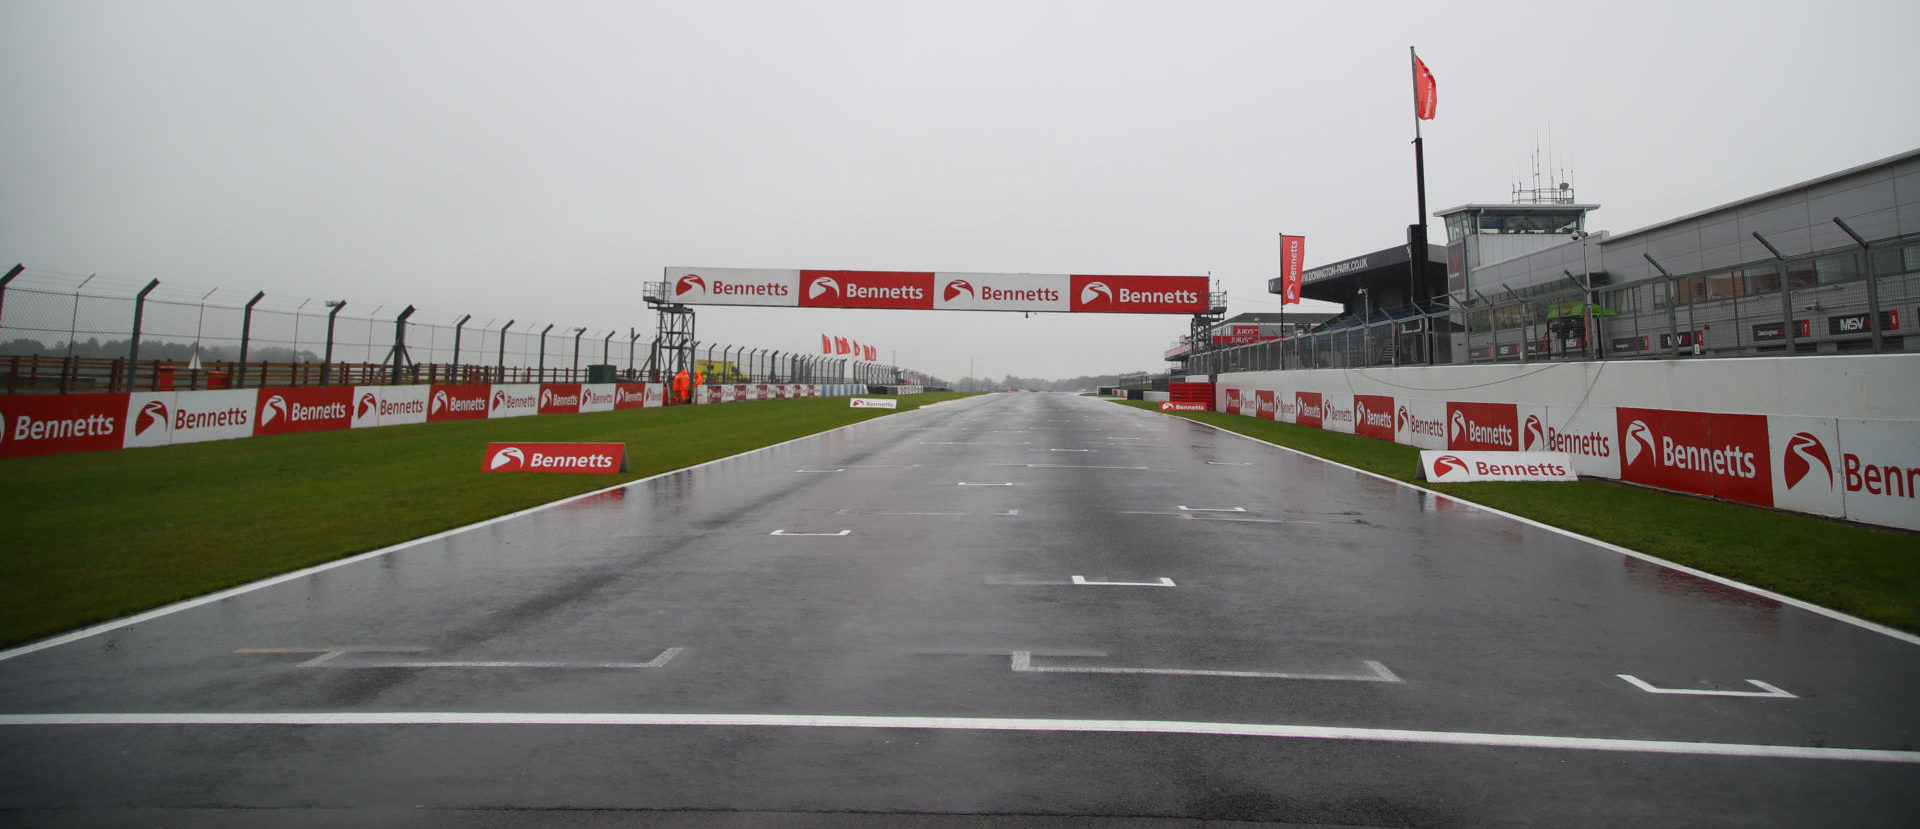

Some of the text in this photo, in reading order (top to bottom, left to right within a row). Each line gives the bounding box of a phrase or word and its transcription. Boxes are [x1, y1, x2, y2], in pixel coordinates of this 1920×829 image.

[1288, 240, 1298, 281] Bennetts
[712, 279, 789, 298] Bennetts
[847, 281, 924, 300] Bennetts
[982, 283, 1059, 302] Bennetts
[1119, 286, 1198, 305] Bennetts
[1839, 316, 1865, 331] MSV
[380, 397, 424, 416] Bennetts
[451, 396, 486, 412] Bennetts
[507, 395, 536, 408] Bennetts
[552, 393, 578, 407] Bennetts
[175, 407, 248, 430] Bennetts
[291, 402, 347, 421] Bennetts
[1332, 407, 1353, 423] Bennetts
[1367, 409, 1392, 428] Bennetts
[14, 413, 115, 440] Bennetts
[1411, 417, 1444, 437] Bennetts
[1469, 420, 1513, 447] Bennetts
[1548, 426, 1610, 458] Bennetts
[530, 453, 613, 469] Bennetts
[1663, 436, 1756, 479] Bennetts
[1476, 461, 1566, 477] Bennetts
